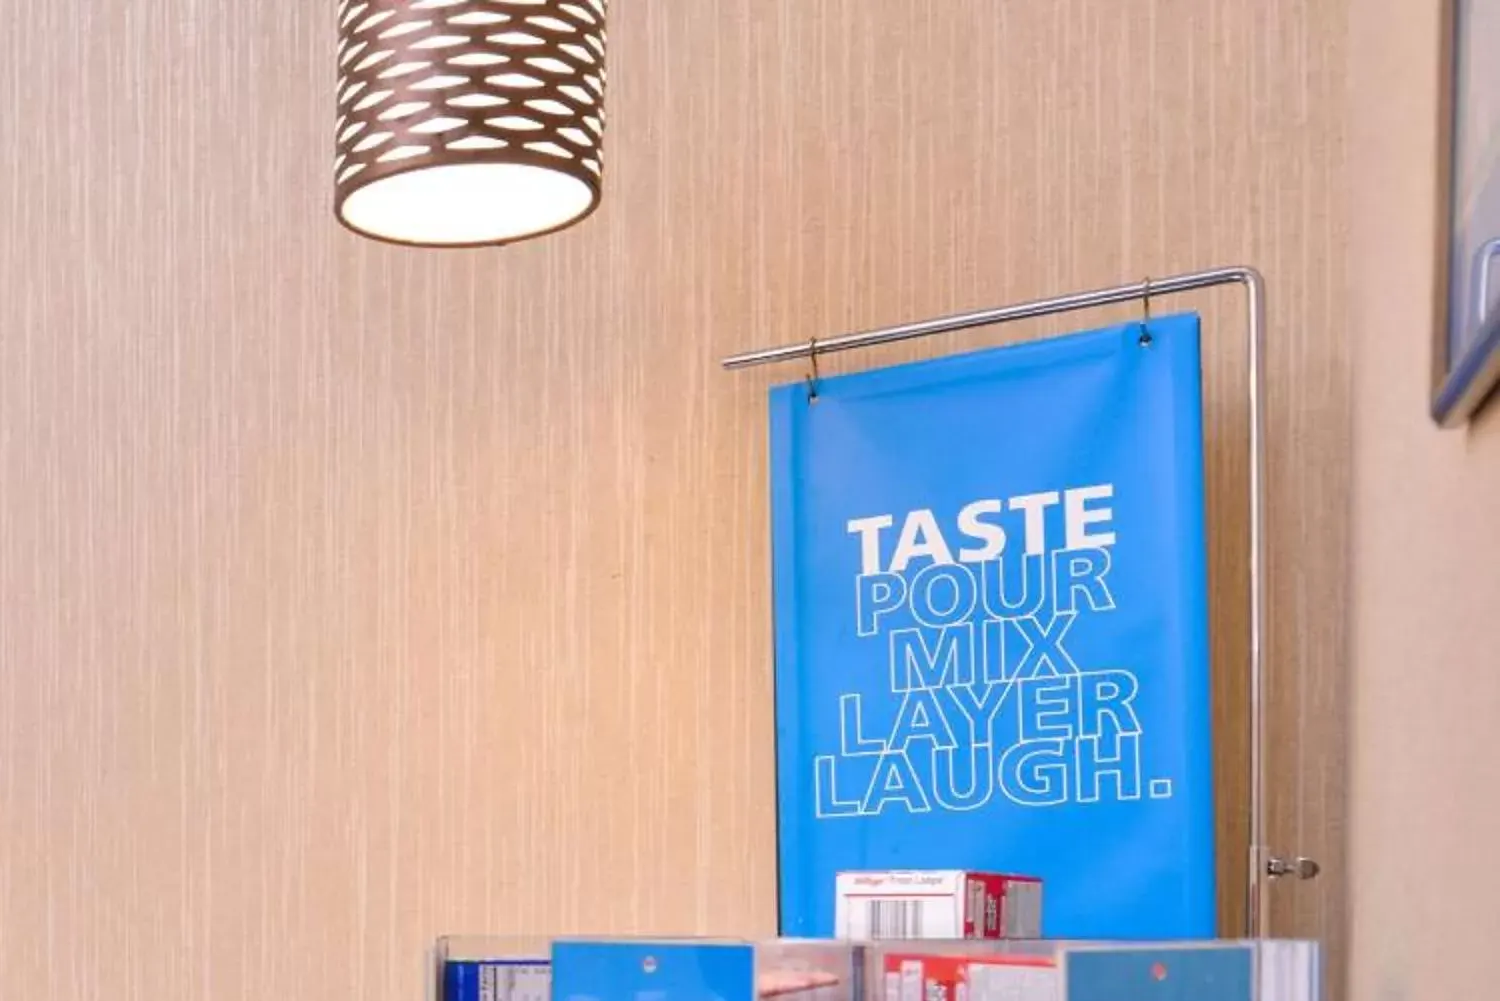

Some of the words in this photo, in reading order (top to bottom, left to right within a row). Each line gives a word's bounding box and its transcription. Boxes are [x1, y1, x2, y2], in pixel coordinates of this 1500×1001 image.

[847, 484, 1116, 575] TASTE
[857, 546, 1116, 636] POUR
[890, 610, 1081, 693] MIX
[839, 669, 1142, 756] LAYER
[814, 732, 1173, 819] LAUGH.
